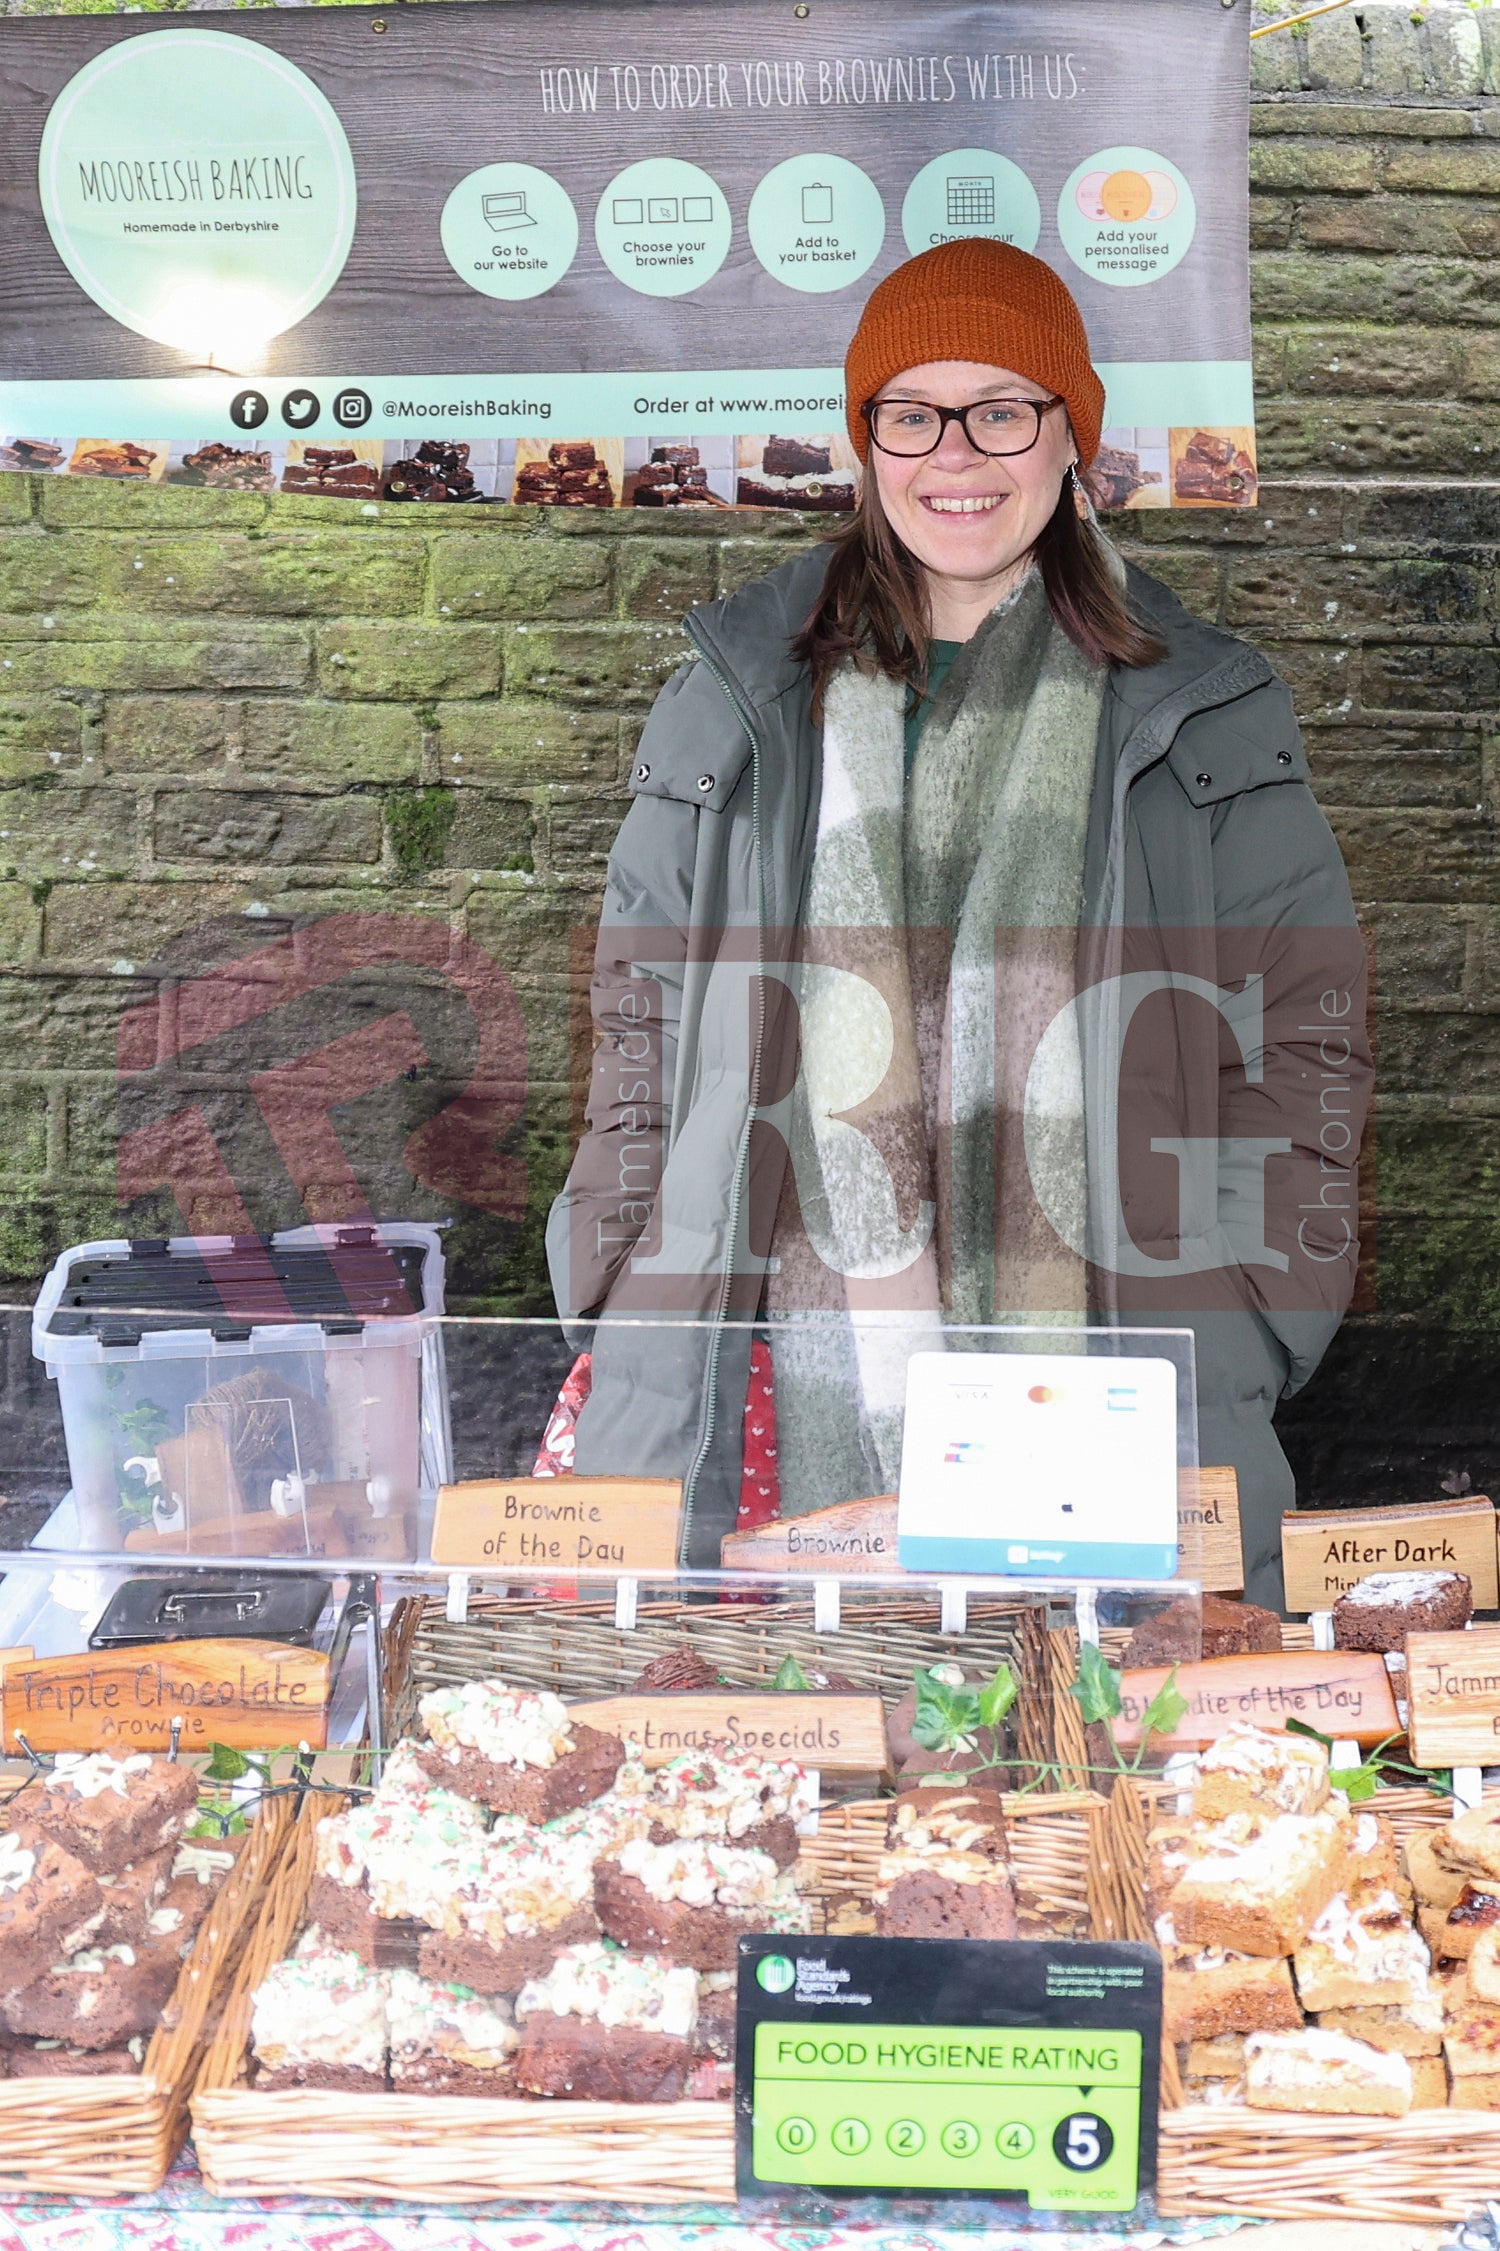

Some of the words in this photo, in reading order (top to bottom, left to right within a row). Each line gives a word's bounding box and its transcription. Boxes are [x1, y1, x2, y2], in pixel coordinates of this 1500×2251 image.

[540, 66, 598, 113] HOW
[609, 64, 640, 112] TO
[651, 62, 732, 111] ORDER
[741, 61, 809, 108] YOUR
[818, 55, 957, 103] BROWNIES
[966, 53, 1034, 100] WITH
[79, 158, 202, 203] MOOREISH
[211, 155, 314, 201] BAKING
[123, 221, 197, 234] Homemade
[199, 221, 212, 233] in
[214, 220, 280, 235] Derbyshire
[795, 236, 821, 249] Add
[823, 238, 840, 249] to
[1096, 230, 1125, 242] Add
[1128, 231, 1158, 244] your
[491, 245, 511, 257] Go
[514, 245, 528, 256] to
[622, 241, 674, 254] Choose
[677, 241, 706, 256] your
[778, 252, 809, 265] your
[811, 249, 857, 262] basket
[1085, 243, 1170, 258] personalised
[473, 260, 495, 271] our
[498, 258, 549, 270] website
[635, 253, 694, 267] brownies
[1097, 258, 1158, 271] message
[382, 399, 552, 420] @MooreishBaking
[634, 397, 691, 414] Order
[695, 396, 714, 413] at
[505, 1495, 602, 1523] Brownie
[483, 1531, 507, 1555] of
[520, 1533, 562, 1558] the
[787, 1527, 886, 1555] Brownie
[1323, 1540, 1388, 1563] After
[1394, 1538, 1457, 1562] Dark
[16, 1668, 120, 1721] Triple
[135, 1663, 308, 1708] Chocolate
[1238, 1687, 1259, 1713] of
[1267, 1686, 1306, 1713] the
[1315, 1683, 1363, 1717] Day
[726, 1715, 841, 1750] Specials
[796, 1957, 826, 1972] Food
[777, 2041, 867, 2066] FOOD
[878, 2044, 1003, 2069] HYGIENE
[1013, 2046, 1119, 2071] RATING
[788, 2125, 804, 2145] 0
[844, 2126, 855, 2147] 1
[898, 2127, 913, 2149] 2
[953, 2129, 967, 2149] 3
[1006, 2130, 1022, 2150] 4
[1065, 2117, 1101, 2167] 5
[1047, 2188, 1077, 2198] VERY
